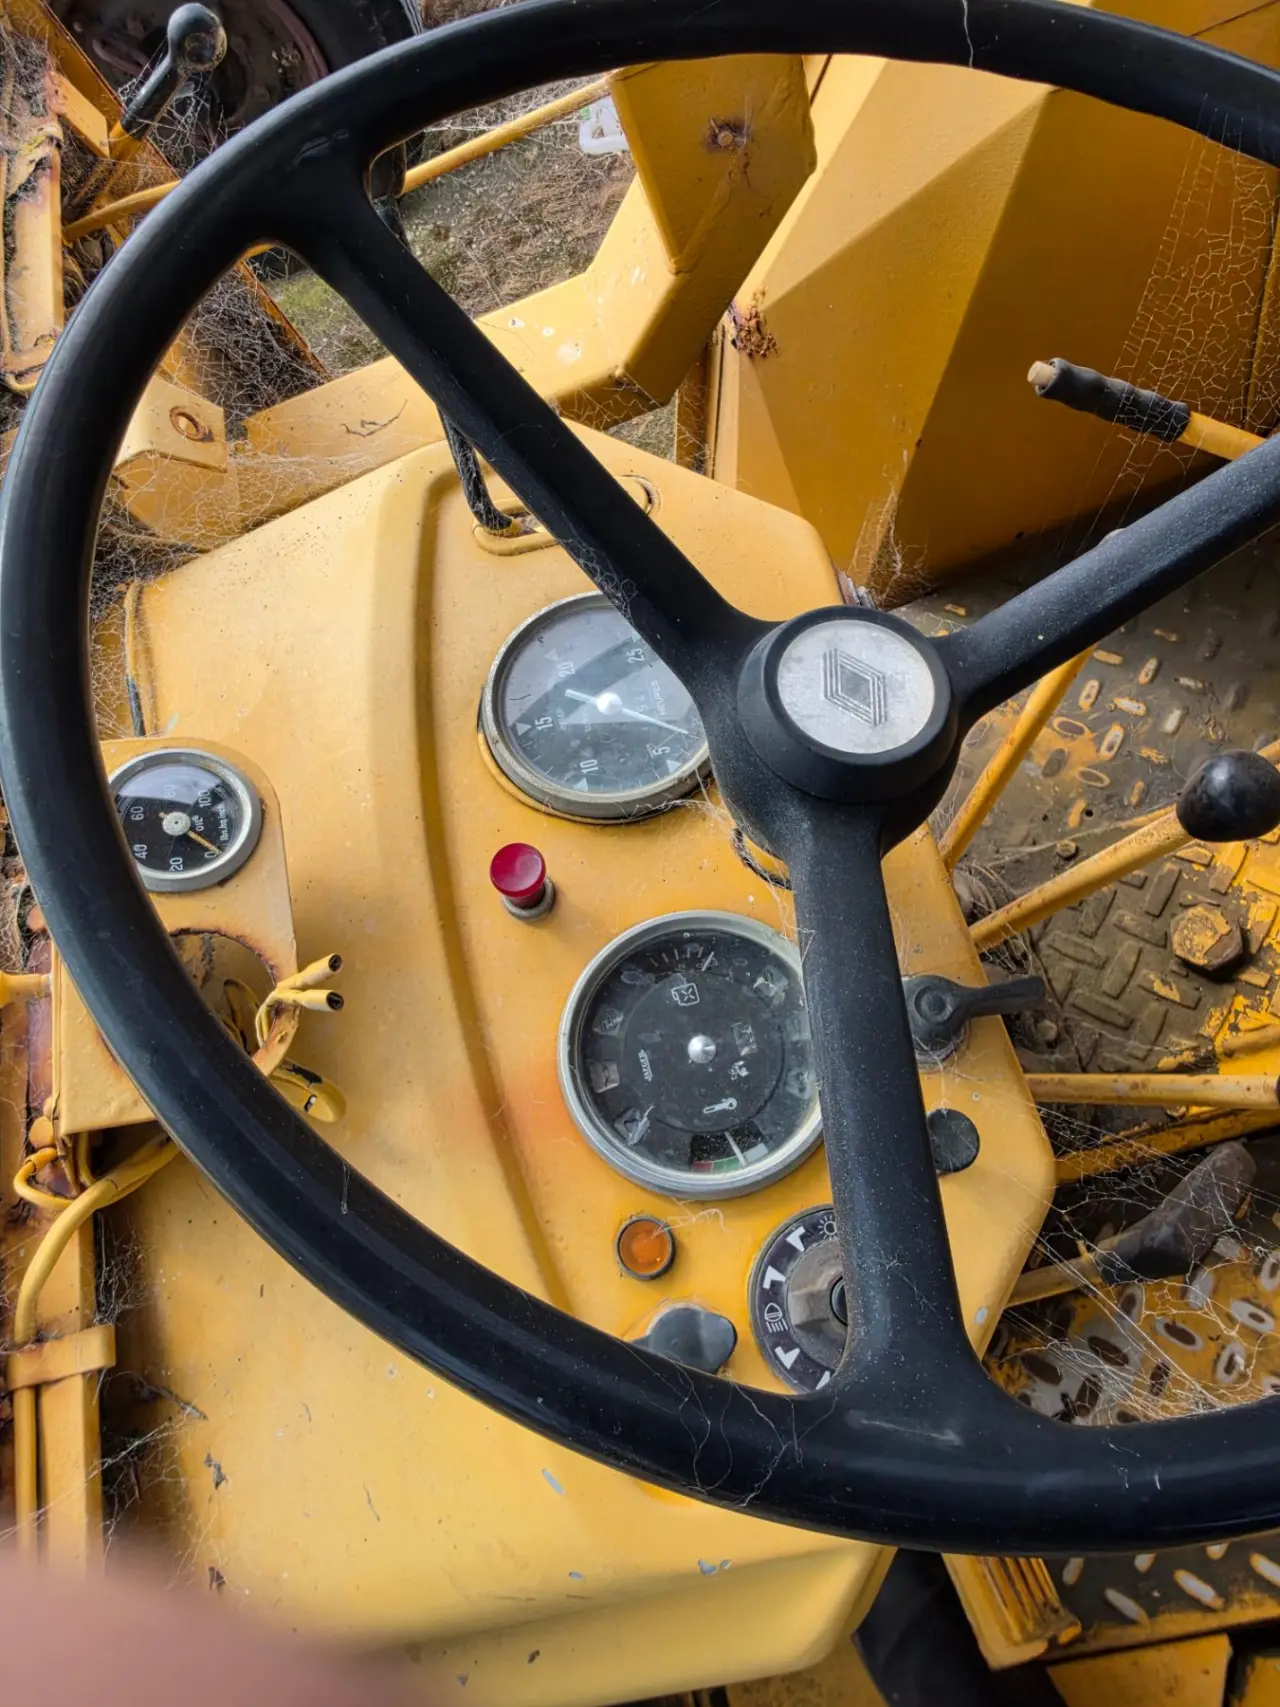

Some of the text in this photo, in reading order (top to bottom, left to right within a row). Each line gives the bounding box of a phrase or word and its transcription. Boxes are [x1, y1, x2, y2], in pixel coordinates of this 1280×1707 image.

[627, 648, 645, 664] 25
[558, 661, 575, 677] 20
[651, 680, 666, 716] HEURES
[534, 716, 553, 732] 15
[579, 759, 599, 774] 10
[163, 785, 176, 798] 80
[198, 789, 211, 809] 100
[131, 806, 144, 820] 60
[133, 844, 147, 860] 40
[170, 857, 183, 871] 20
